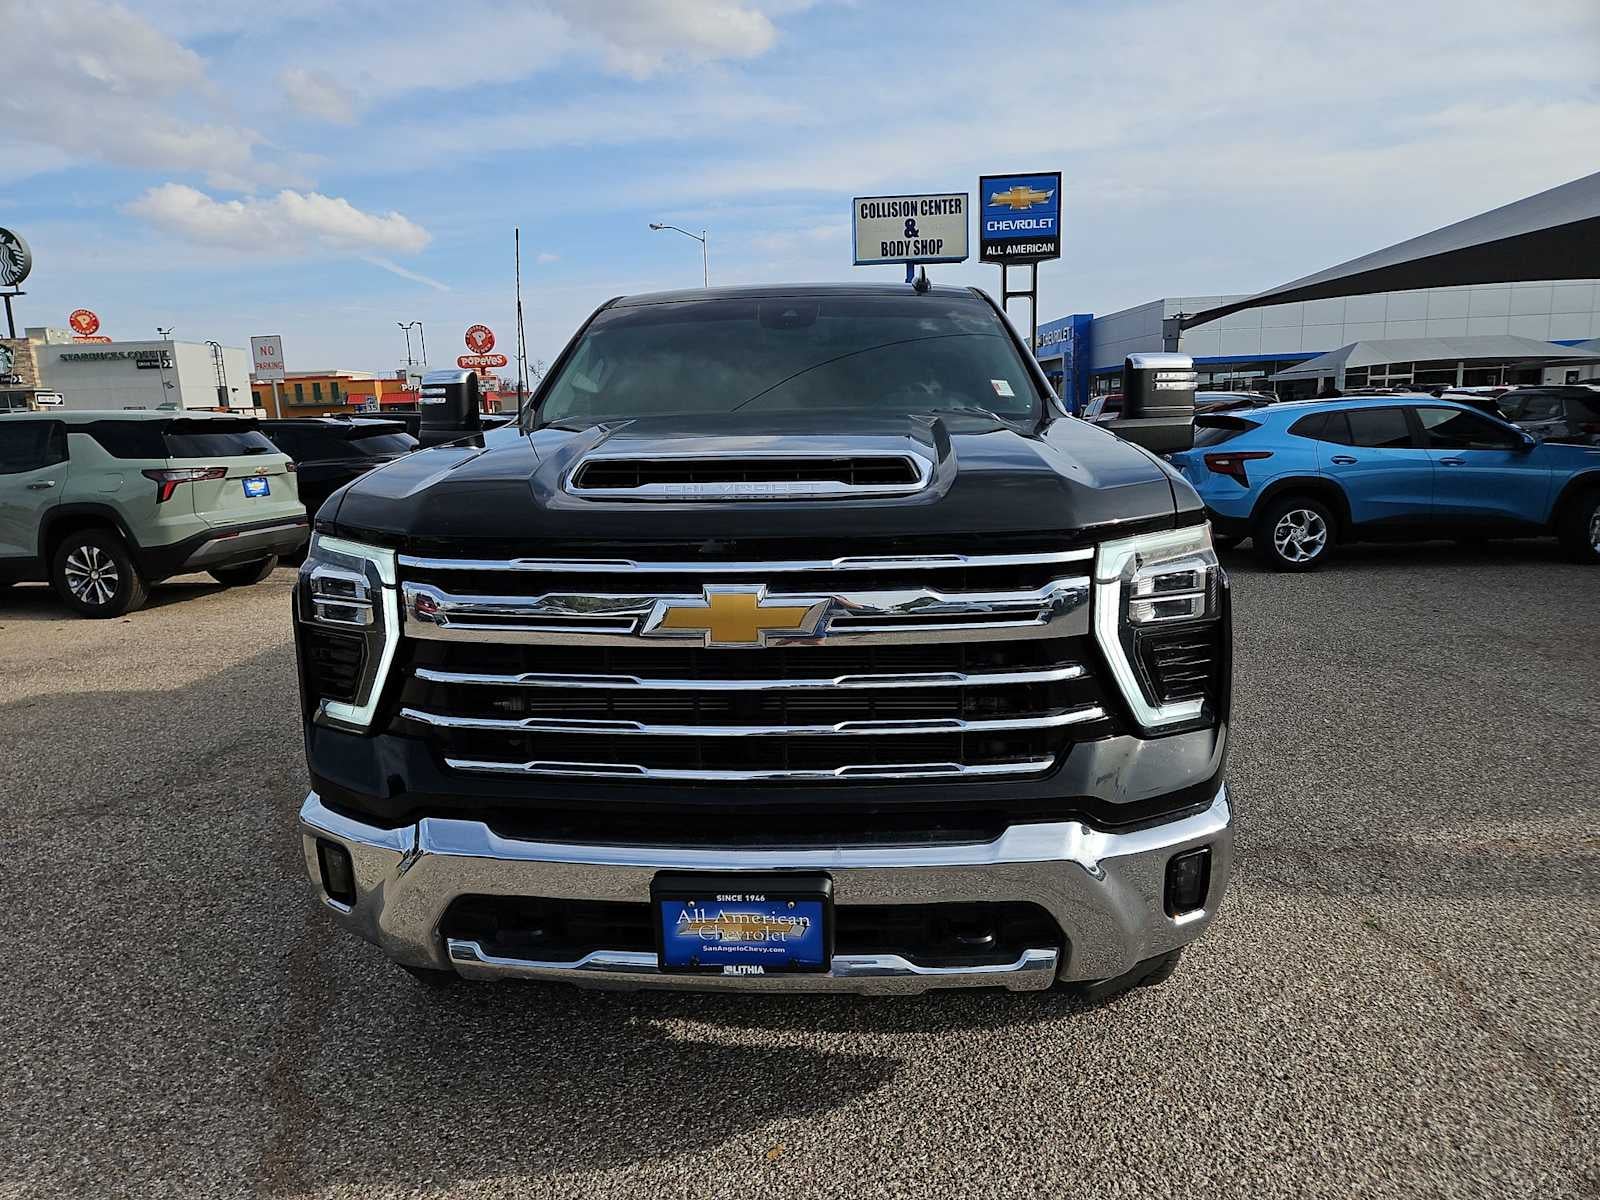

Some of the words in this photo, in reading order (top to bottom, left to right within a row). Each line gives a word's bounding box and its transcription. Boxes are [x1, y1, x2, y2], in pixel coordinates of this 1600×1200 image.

[860, 201, 918, 219] COLLISION
[920, 198, 962, 216] CENTER
[904, 218, 920, 239] &
[986, 218, 1054, 231] CHEVROLET
[881, 239, 911, 257] BODY
[913, 239, 943, 255] SHOP
[986, 245, 1004, 255] ALL
[1005, 243, 1055, 254] AMERICAN
[60, 350, 126, 362] STARBUCKS
[260, 345, 274, 356] NO
[255, 360, 284, 370] PARKING
[716, 894, 743, 902] SINCE
[745, 894, 766, 902] 1946
[676, 909, 706, 924] All
[713, 909, 811, 927] American
[698, 923, 787, 942] Chevrolet
[702, 945, 786, 953] SanAngeloChevy.com
[733, 965, 765, 974] LITHIA
